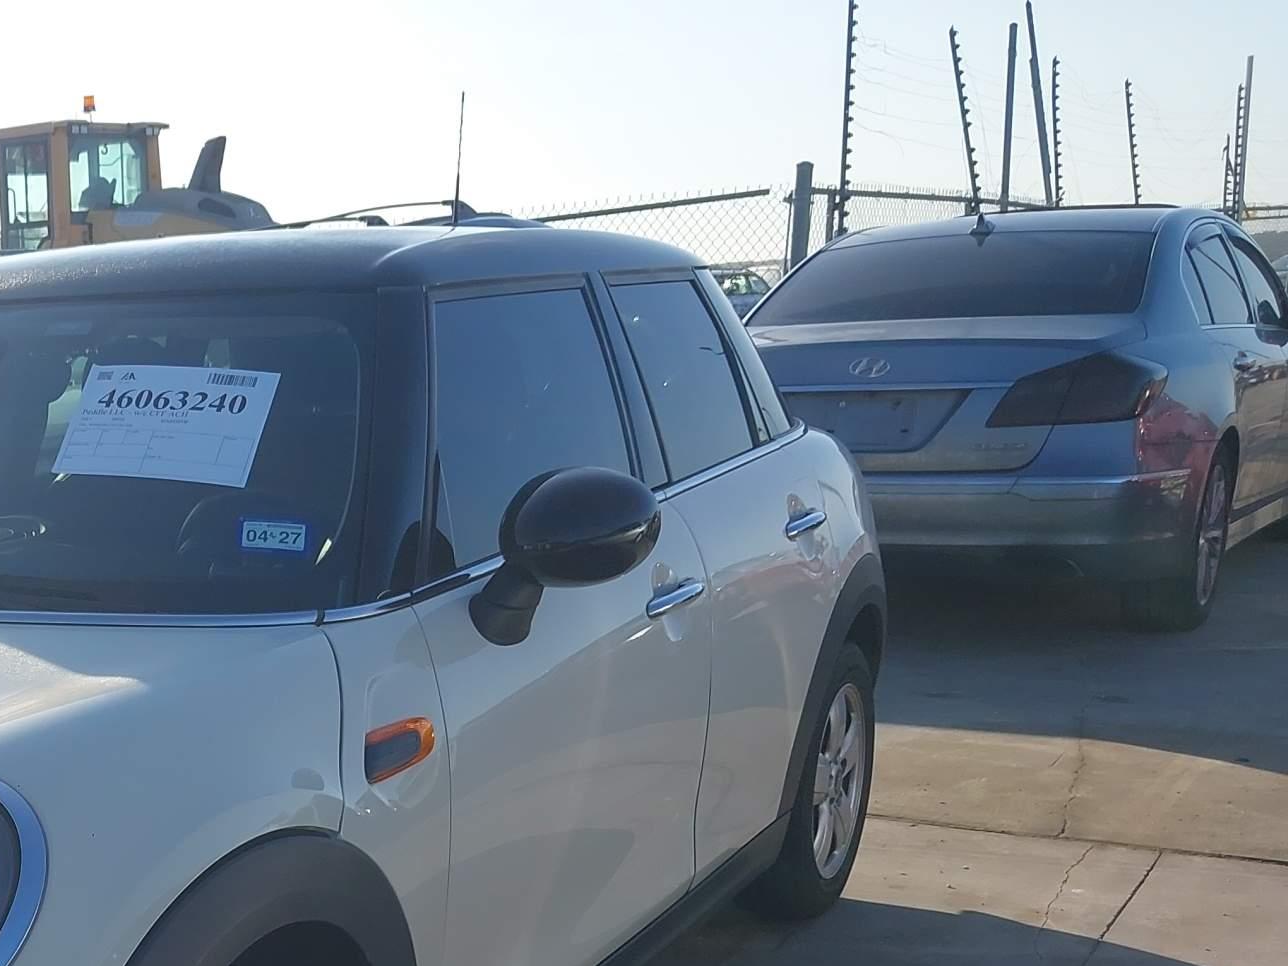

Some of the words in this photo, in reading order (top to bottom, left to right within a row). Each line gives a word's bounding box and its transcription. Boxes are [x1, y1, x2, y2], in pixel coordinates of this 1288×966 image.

[97, 389, 247, 414] 46063240
[246, 529, 268, 543] 04
[279, 531, 302, 545] 27
